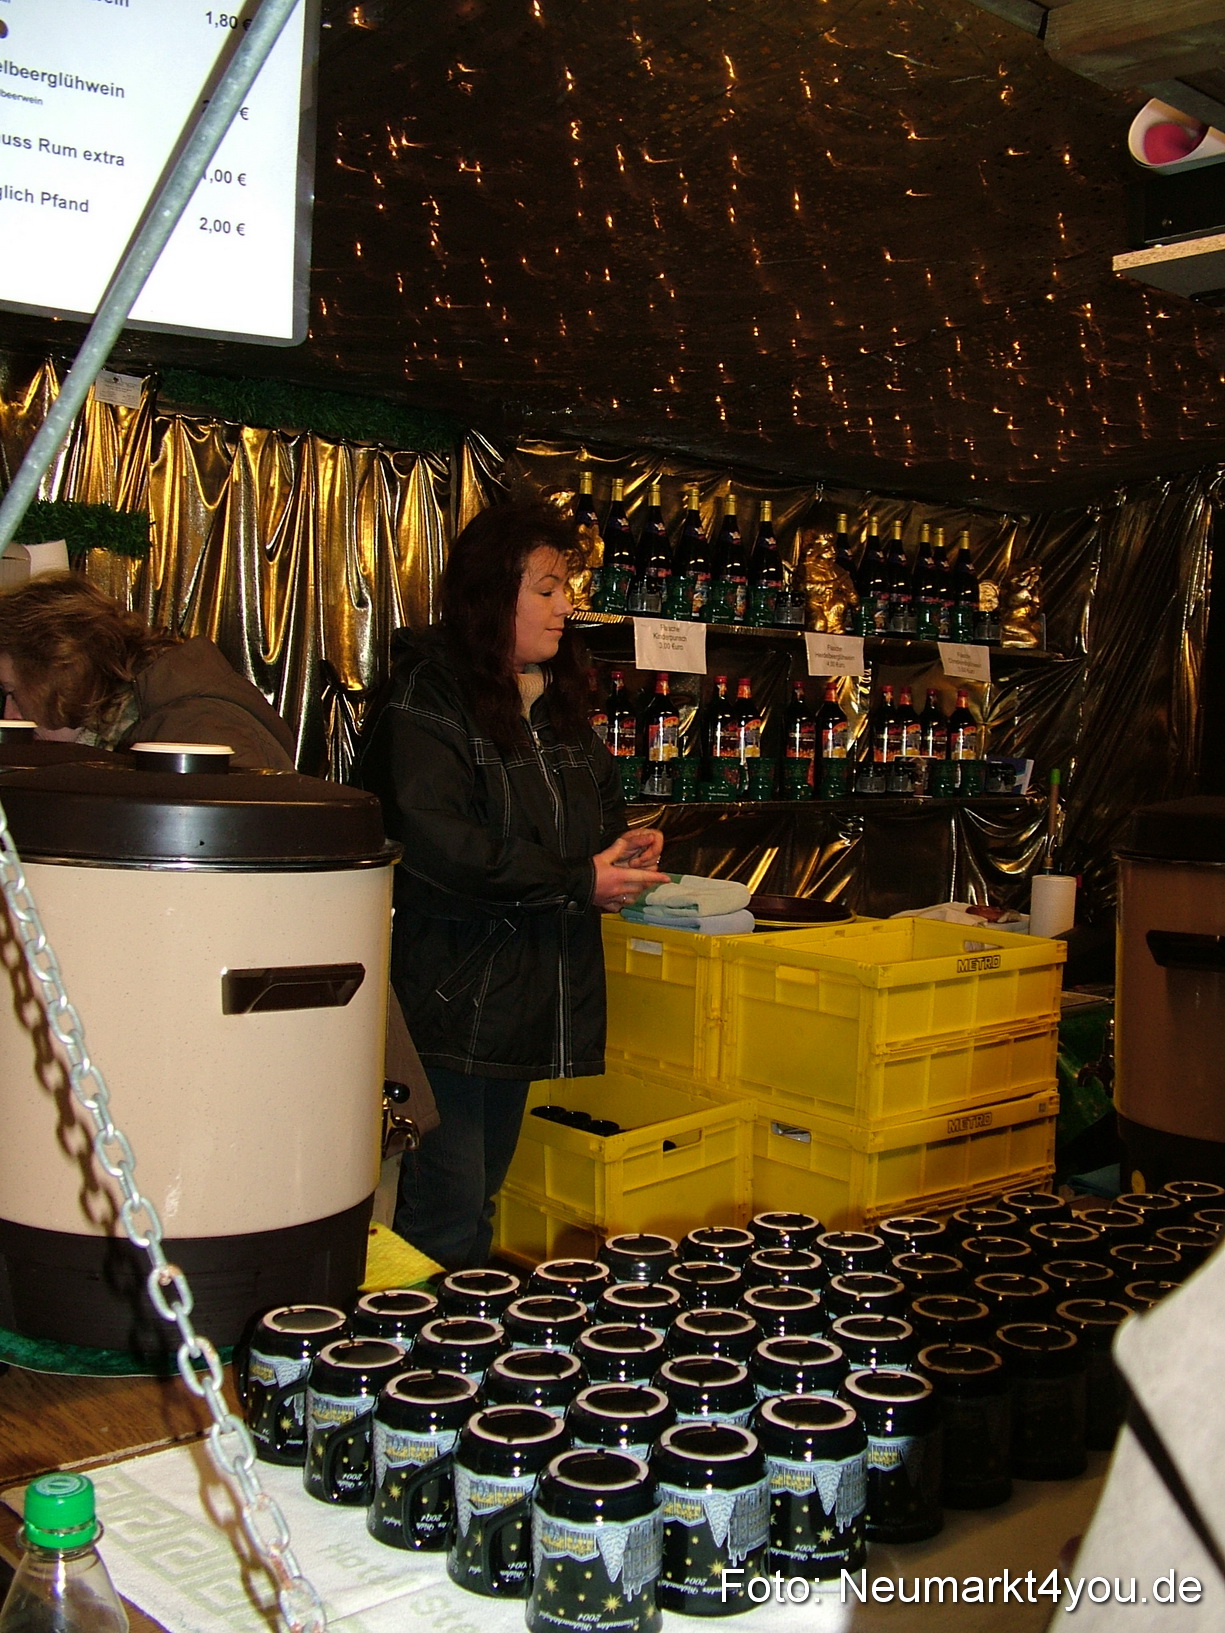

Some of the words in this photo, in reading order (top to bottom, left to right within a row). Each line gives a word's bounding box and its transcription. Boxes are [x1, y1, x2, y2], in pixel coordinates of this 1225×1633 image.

[205, 11, 238, 29] 1,80
[0, 60, 125, 98] lbeerglühwein
[38, 137, 77, 158] Rum
[83, 149, 125, 166] extra
[237, 173, 247, 186] €
[0, 185, 34, 203] lich
[40, 191, 89, 213] Pfand
[199, 217, 231, 234] 2,00
[236, 223, 246, 236] €
[956, 954, 1001, 973] METRO
[947, 1112, 993, 1134] METRO
